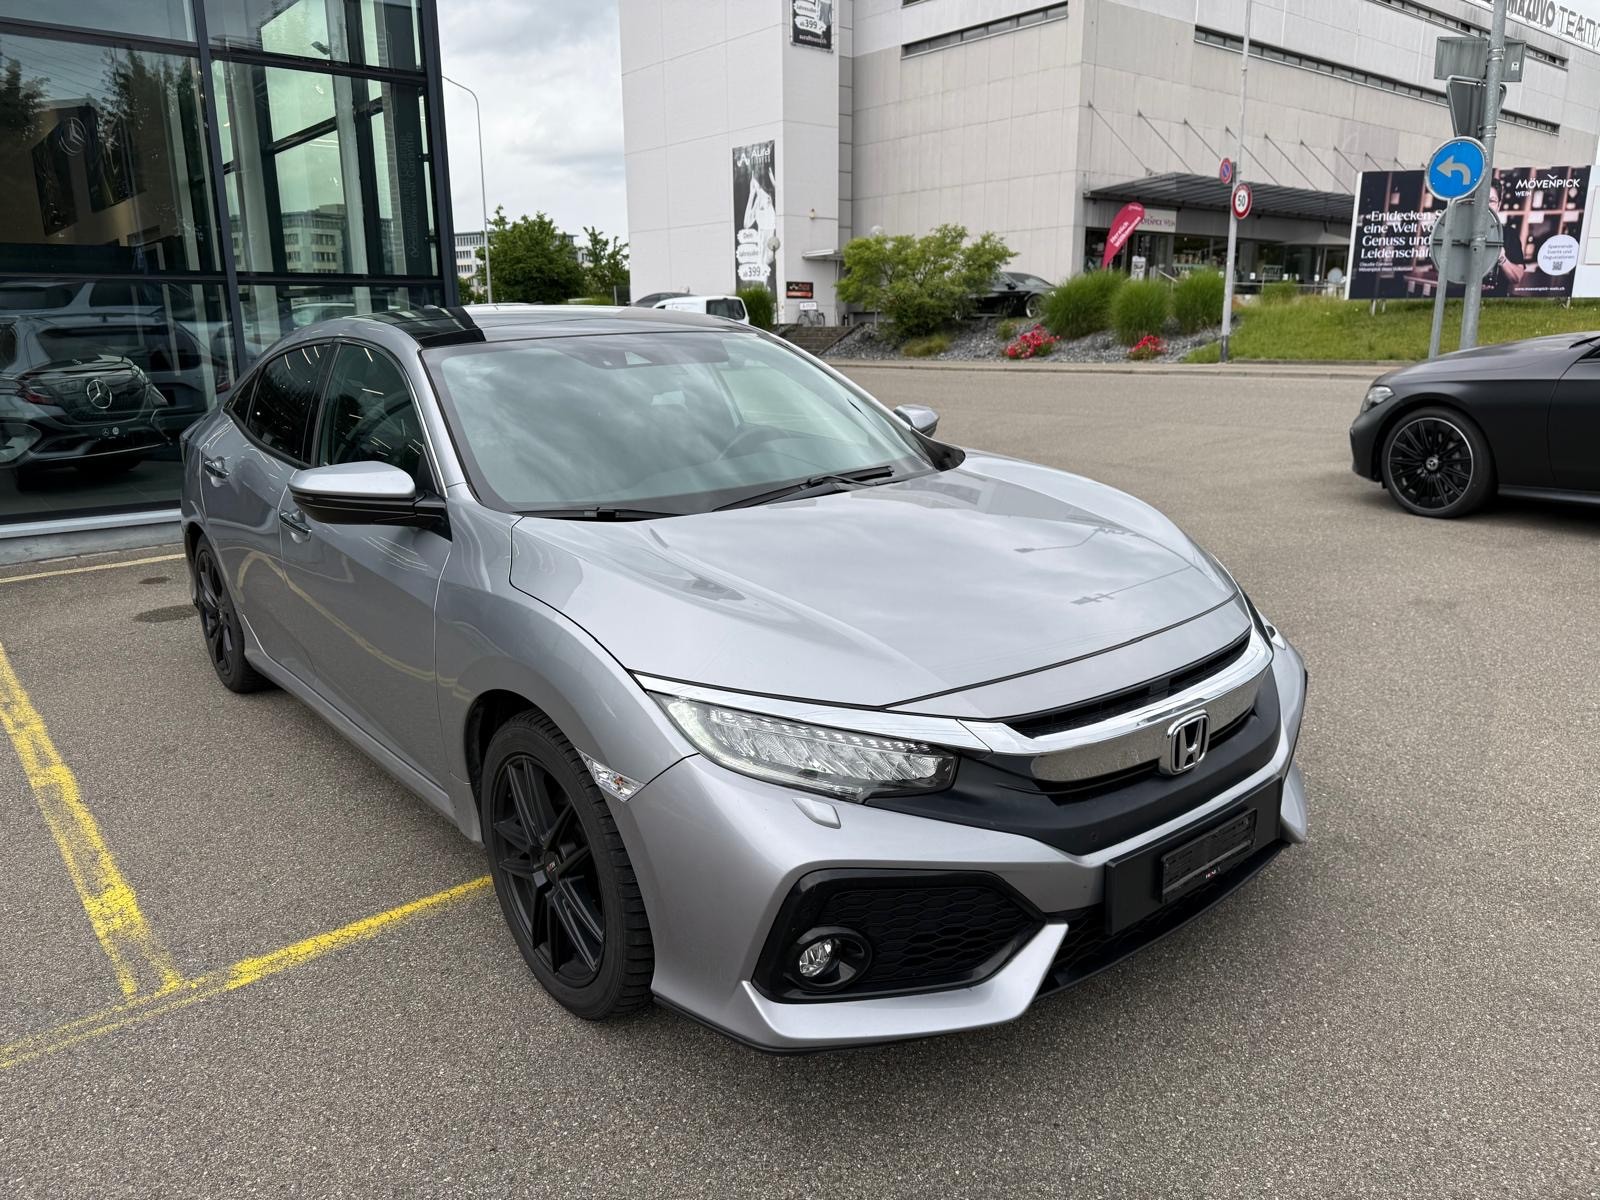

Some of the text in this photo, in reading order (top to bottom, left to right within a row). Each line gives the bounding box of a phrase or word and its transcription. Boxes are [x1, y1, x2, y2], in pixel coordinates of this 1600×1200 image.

[1559, 6, 1600, 46] TEAM
[751, 148, 771, 158] Aura
[1515, 176, 1581, 189] MÖVENPICK
[1237, 194, 1246, 207] 50
[1363, 222, 1434, 234] eine Welt vo
[1362, 235, 1431, 247] Genuss und
[1360, 247, 1432, 259] Leidenschaf
